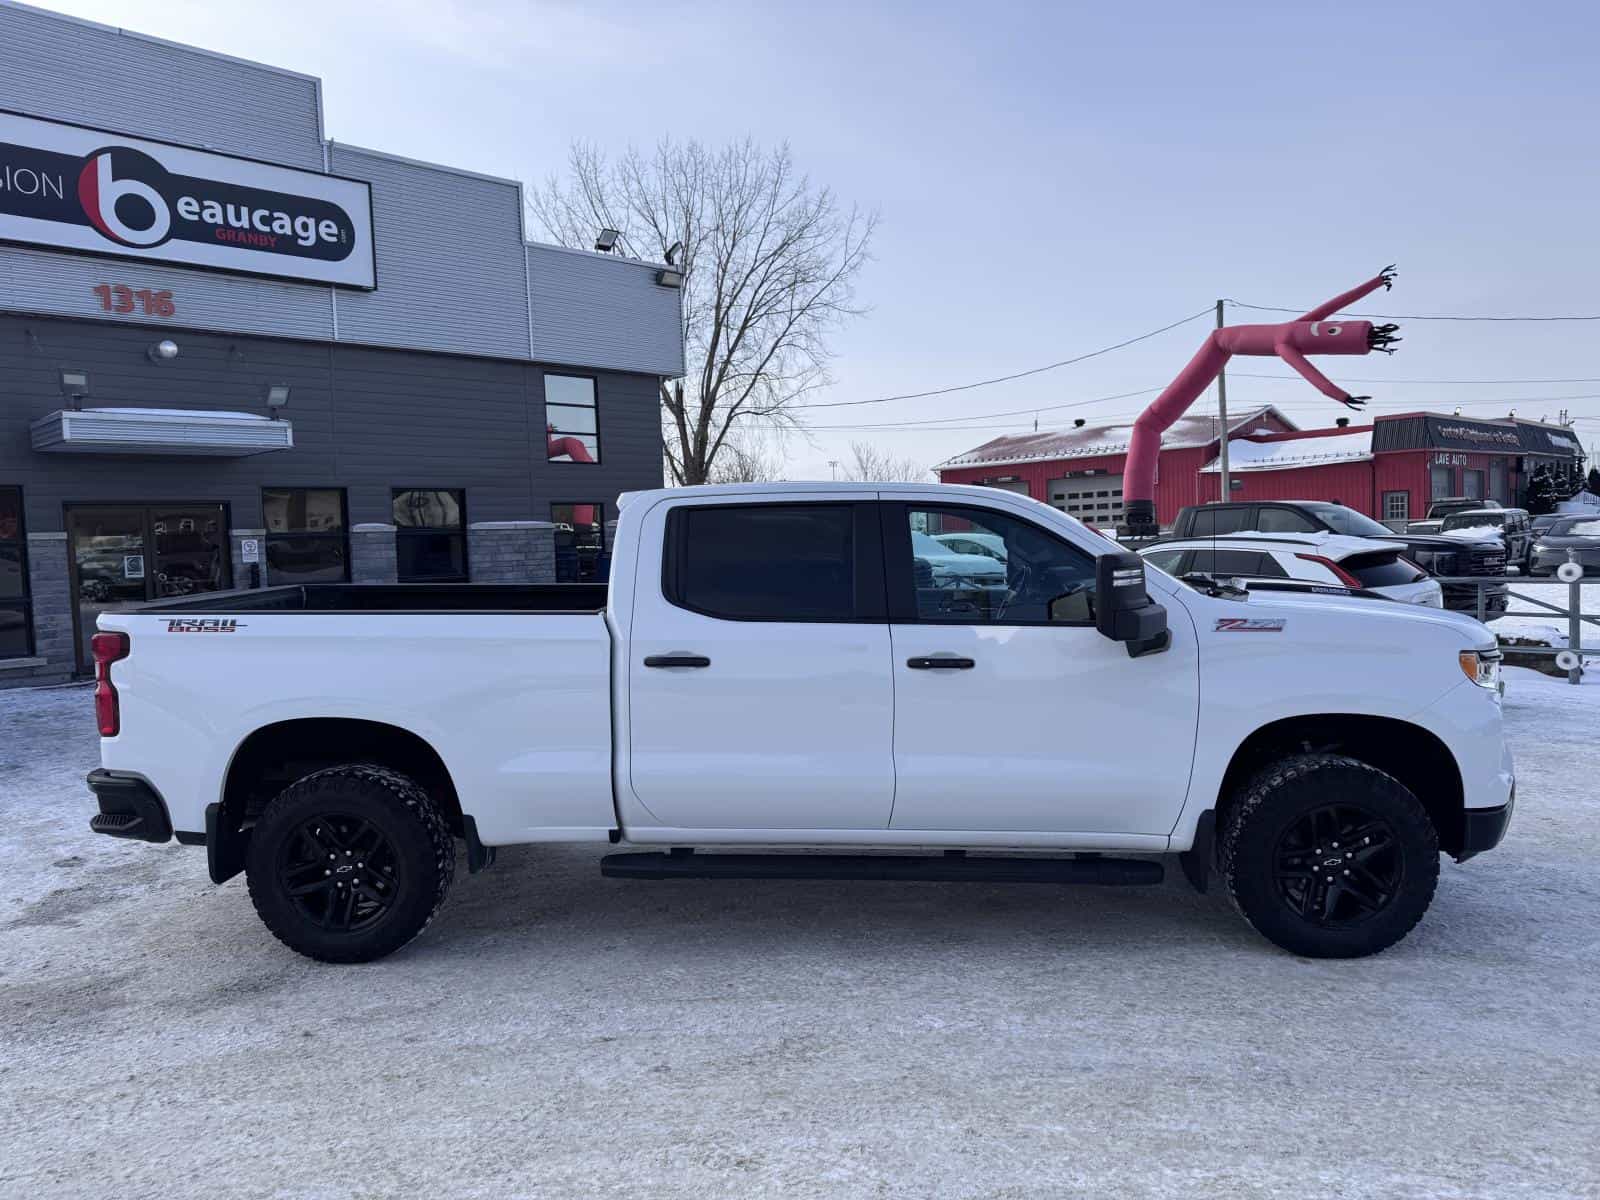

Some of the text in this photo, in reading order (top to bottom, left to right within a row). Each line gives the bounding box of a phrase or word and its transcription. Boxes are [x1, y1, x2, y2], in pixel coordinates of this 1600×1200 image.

[0, 165, 63, 199] ION
[215, 228, 278, 247] GRANBY
[93, 283, 176, 317] 1316
[1452, 454, 1467, 466] AUTO
[158, 618, 248, 627] TRAIL
